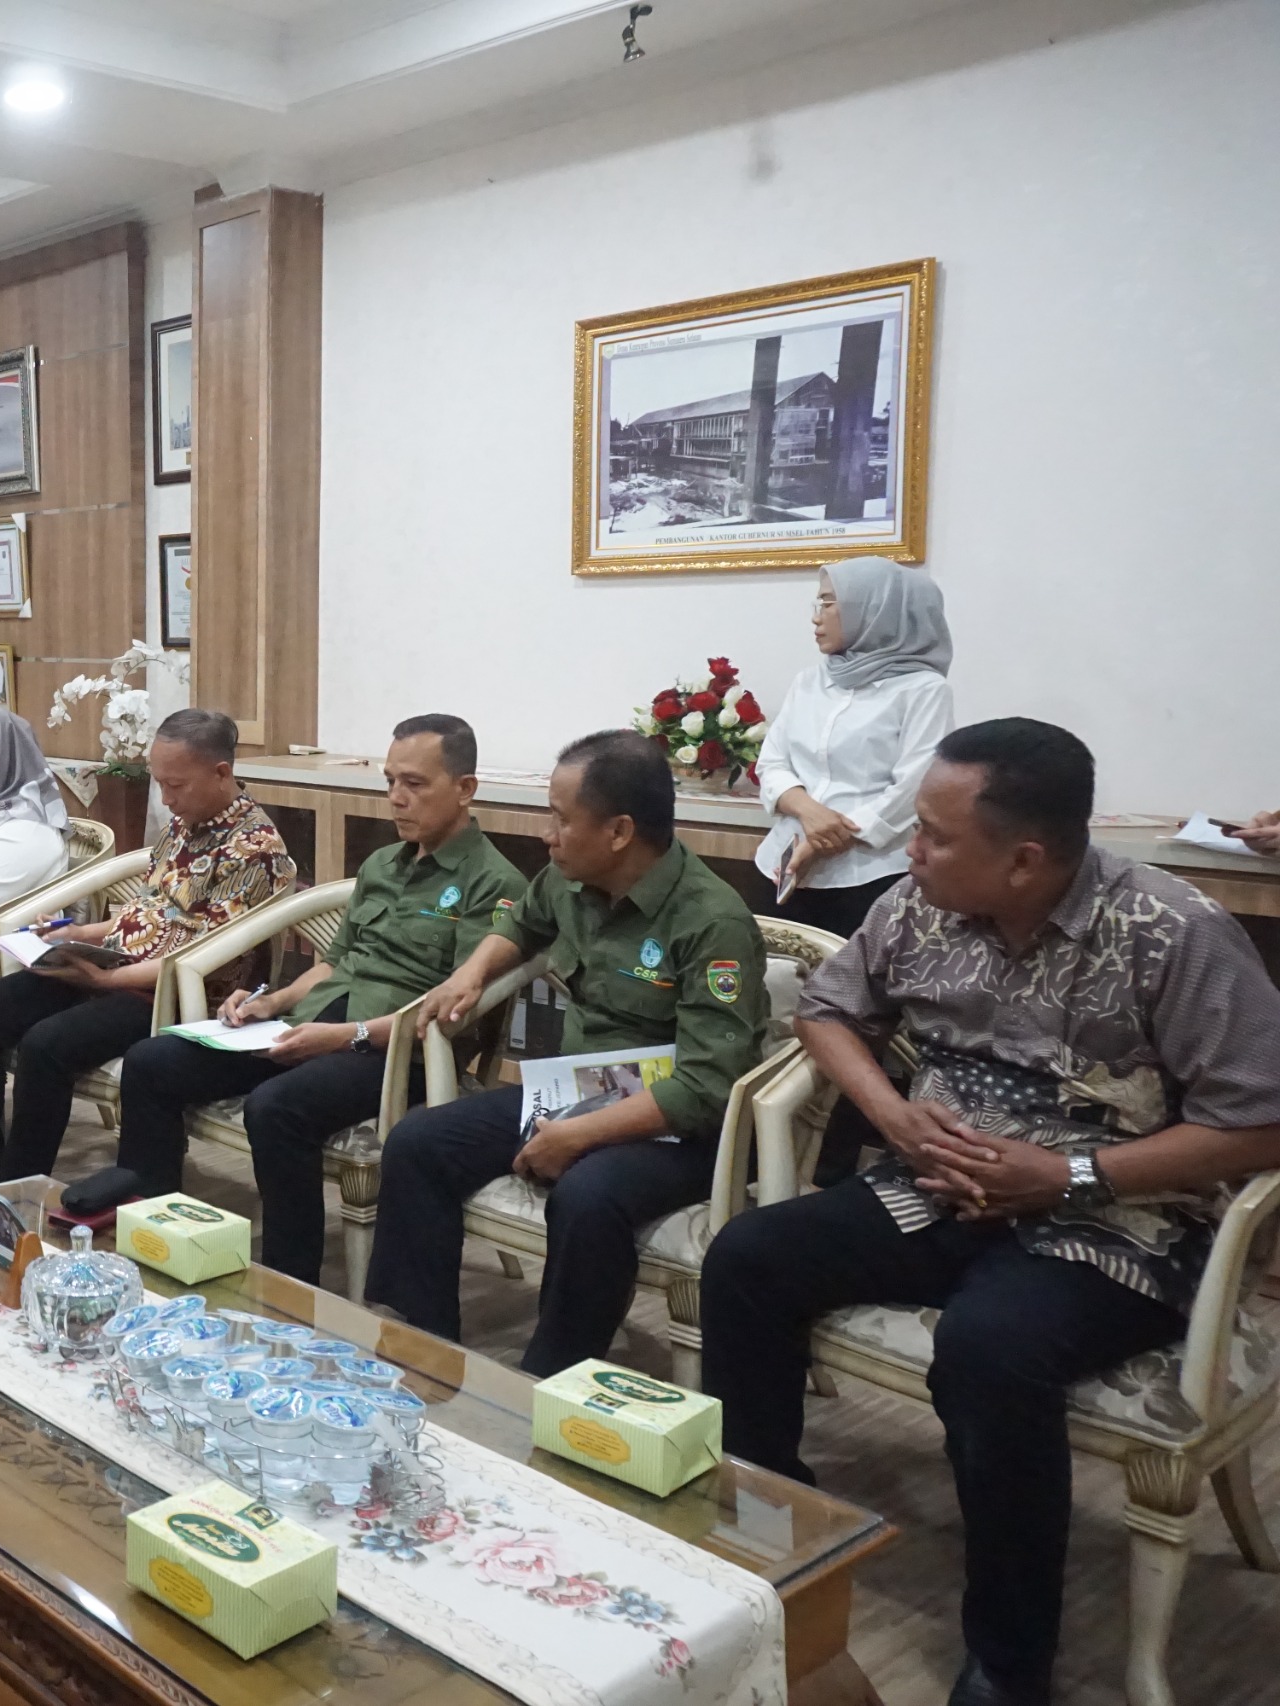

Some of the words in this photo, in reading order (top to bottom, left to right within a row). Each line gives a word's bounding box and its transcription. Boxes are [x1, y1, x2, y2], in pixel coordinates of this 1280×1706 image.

[655, 535, 705, 545] PEMBANGUNAN
[709, 533, 737, 541] KANTOR
[738, 531, 776, 540] GUBERNUR
[776, 529, 804, 537] SUMSEL
[806, 527, 830, 535] TAHUN
[831, 526, 846, 534] 1958
[634, 966, 659, 980] CSR
